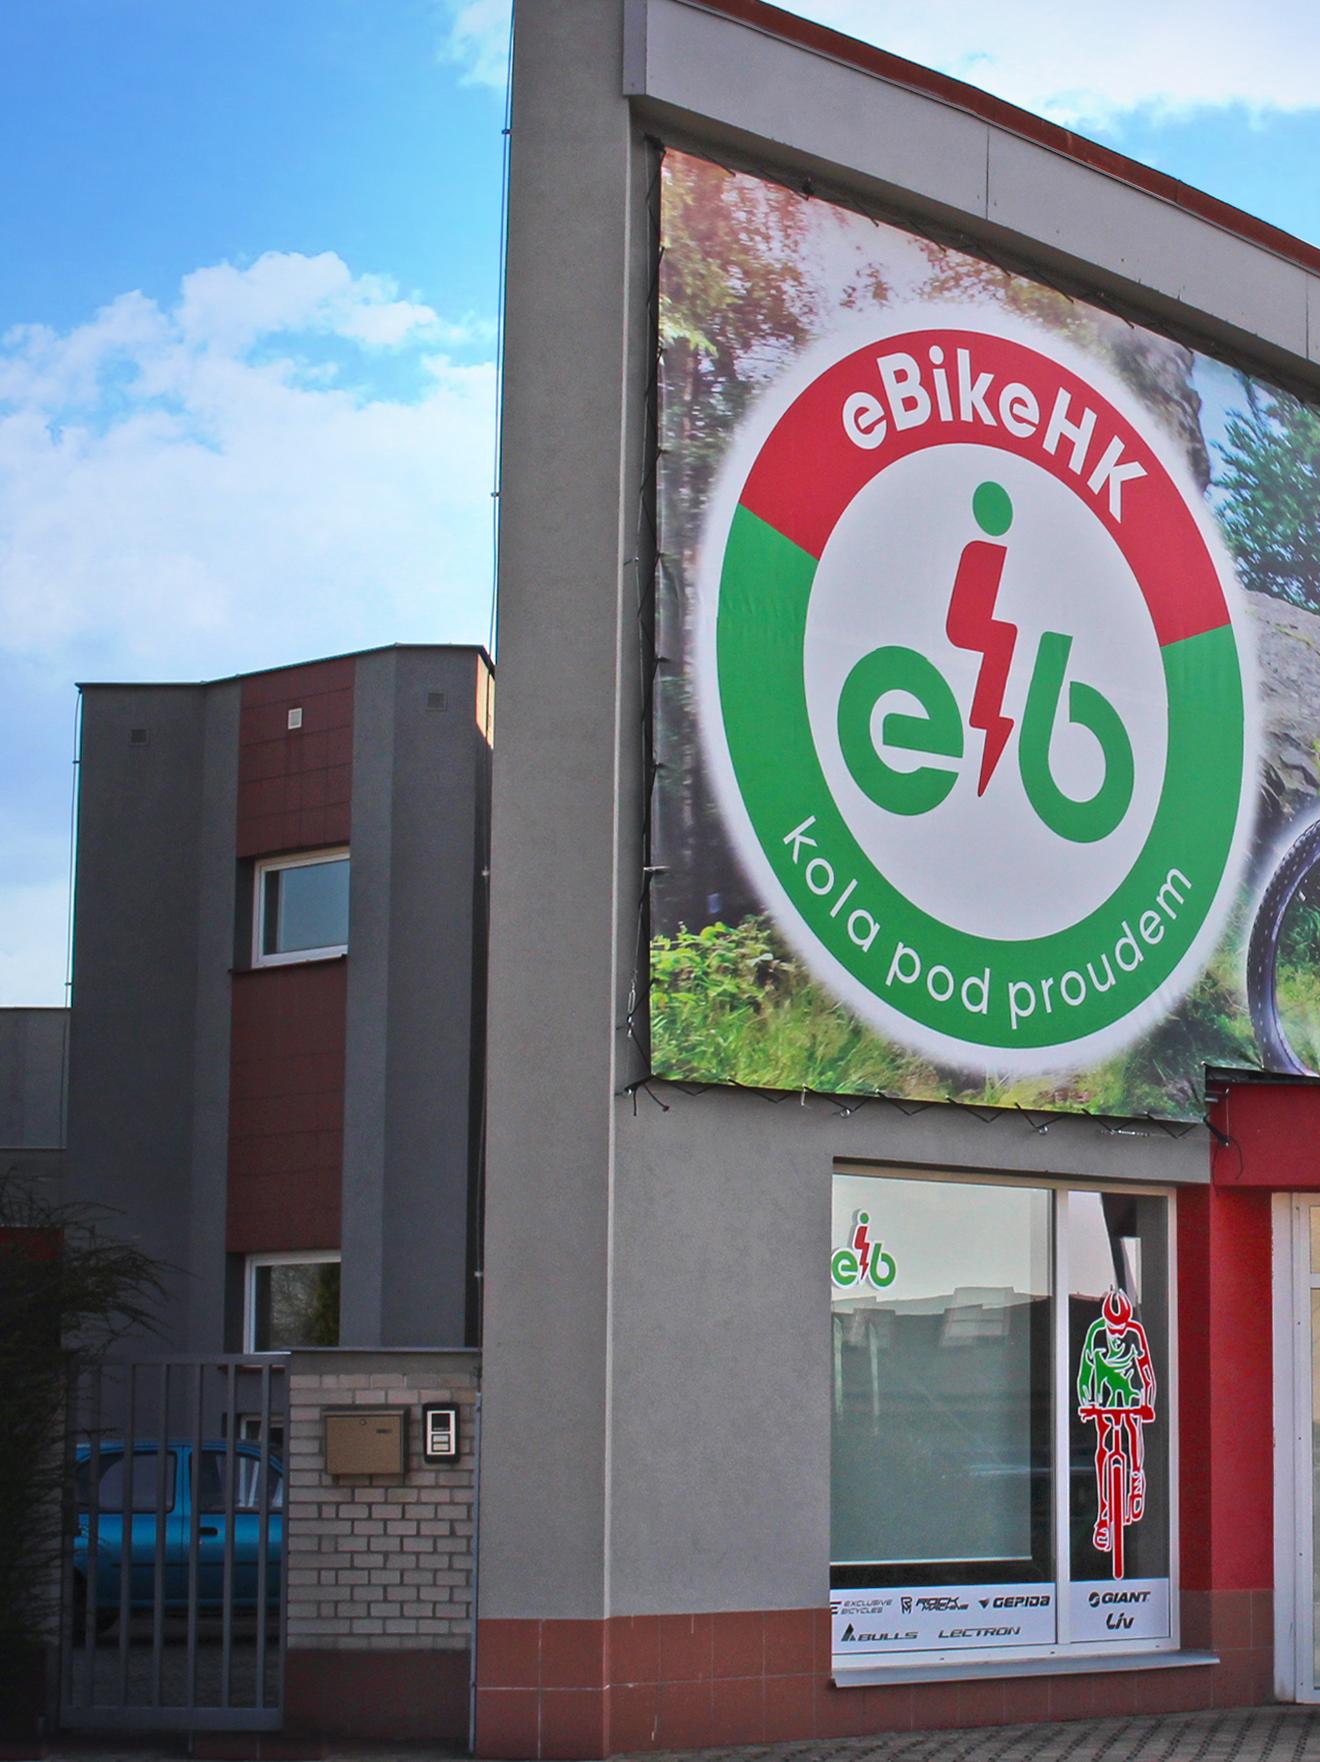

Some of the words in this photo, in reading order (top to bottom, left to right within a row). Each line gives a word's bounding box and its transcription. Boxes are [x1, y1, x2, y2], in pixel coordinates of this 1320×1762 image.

[842, 345, 1147, 523] eBikeHK
[783, 815, 879, 951] kola
[886, 941, 991, 1014] pod
[1009, 868, 1191, 1029] proudem
[1102, 1591, 1151, 1604] GIANT
[1106, 1612, 1134, 1630] Liv
[858, 1631, 919, 1641] BULLS
